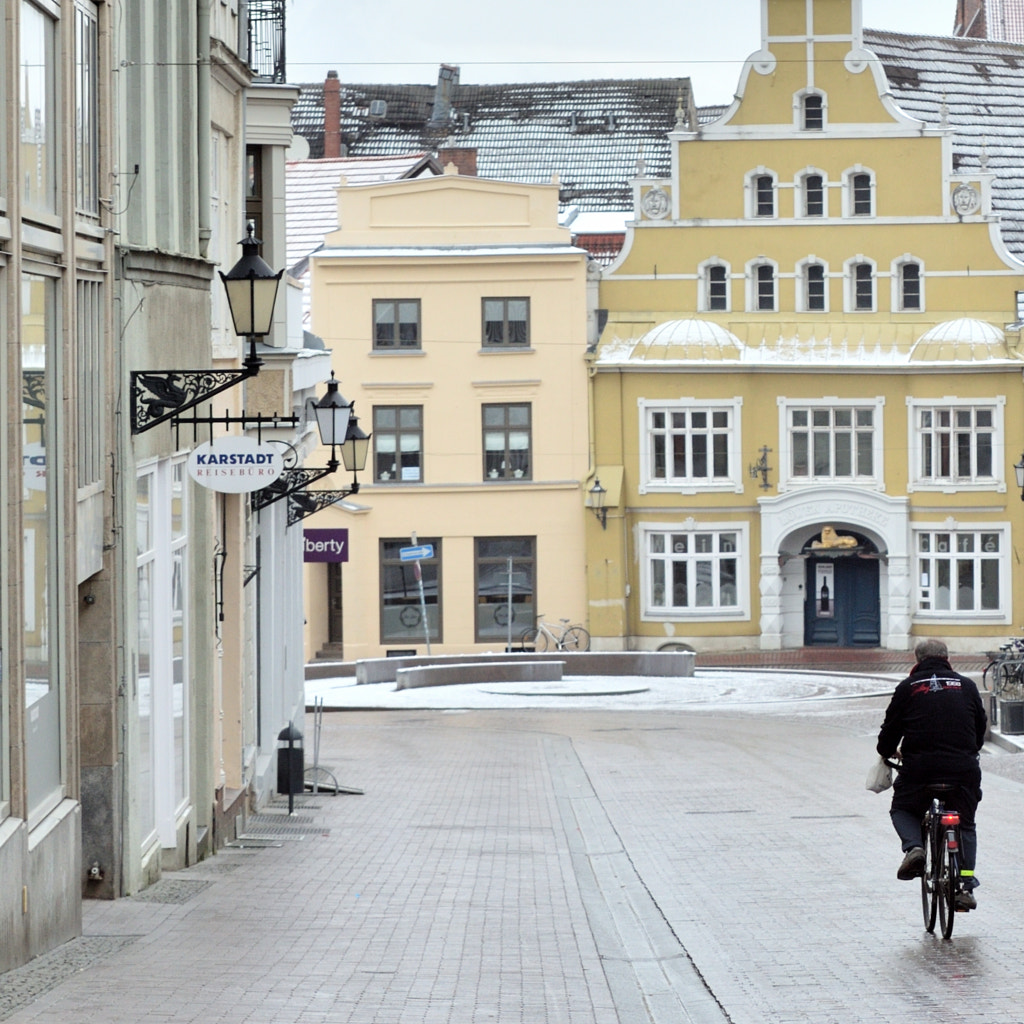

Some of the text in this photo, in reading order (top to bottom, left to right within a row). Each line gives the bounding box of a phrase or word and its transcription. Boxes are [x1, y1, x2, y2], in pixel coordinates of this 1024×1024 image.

[197, 454, 274, 465] KARSTADT
[197, 467, 275, 476] REISEBÜRO
[303, 537, 344, 555] berty
[922, 537, 996, 553] Café
